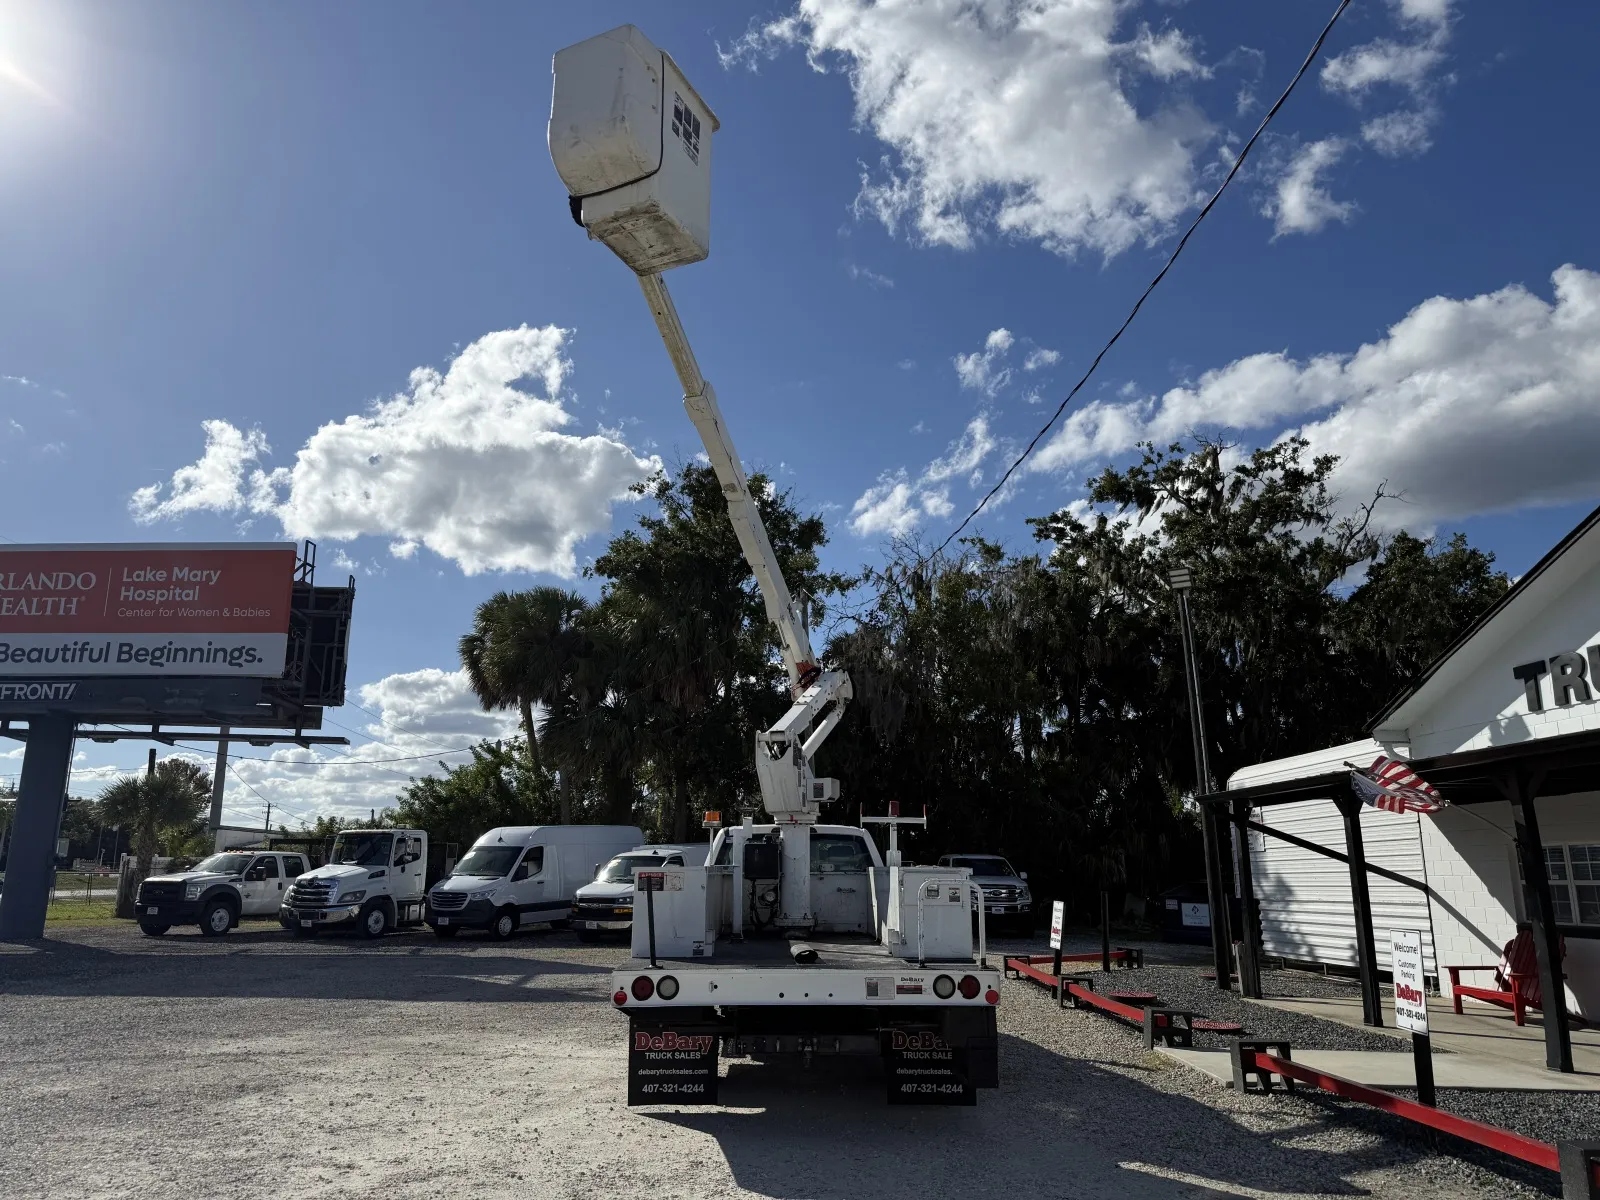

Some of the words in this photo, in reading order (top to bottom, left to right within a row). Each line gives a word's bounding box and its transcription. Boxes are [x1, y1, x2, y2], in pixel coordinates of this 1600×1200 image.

[122, 566, 167, 582] Lake
[172, 567, 221, 586] Mary
[120, 585, 199, 604] Hospital
[0, 597, 79, 617] EALTH
[117, 607, 156, 617] Center
[158, 607, 175, 617] for
[177, 607, 220, 617] Women
[222, 607, 231, 617] &
[232, 607, 271, 617] Babies
[0, 641, 111, 663] Beautiful
[116, 641, 263, 668] Beginnings.
[1394, 942, 1419, 955] Welcome!
[1398, 959, 1417, 970] Customer
[1401, 970, 1415, 982] Parking
[1396, 983, 1422, 1007] DeBary
[1396, 1006, 1426, 1022] 407-321-4244
[635, 1032, 713, 1055] DeBary
[892, 1031, 952, 1051] DeBa
[645, 1051, 673, 1059] TRUCK
[902, 1051, 930, 1059] TRUCK
[638, 1068, 709, 1076] debarytrucksales.com
[642, 1083, 705, 1093] 407-321-4244
[901, 1083, 964, 1093] 407-321-4244
